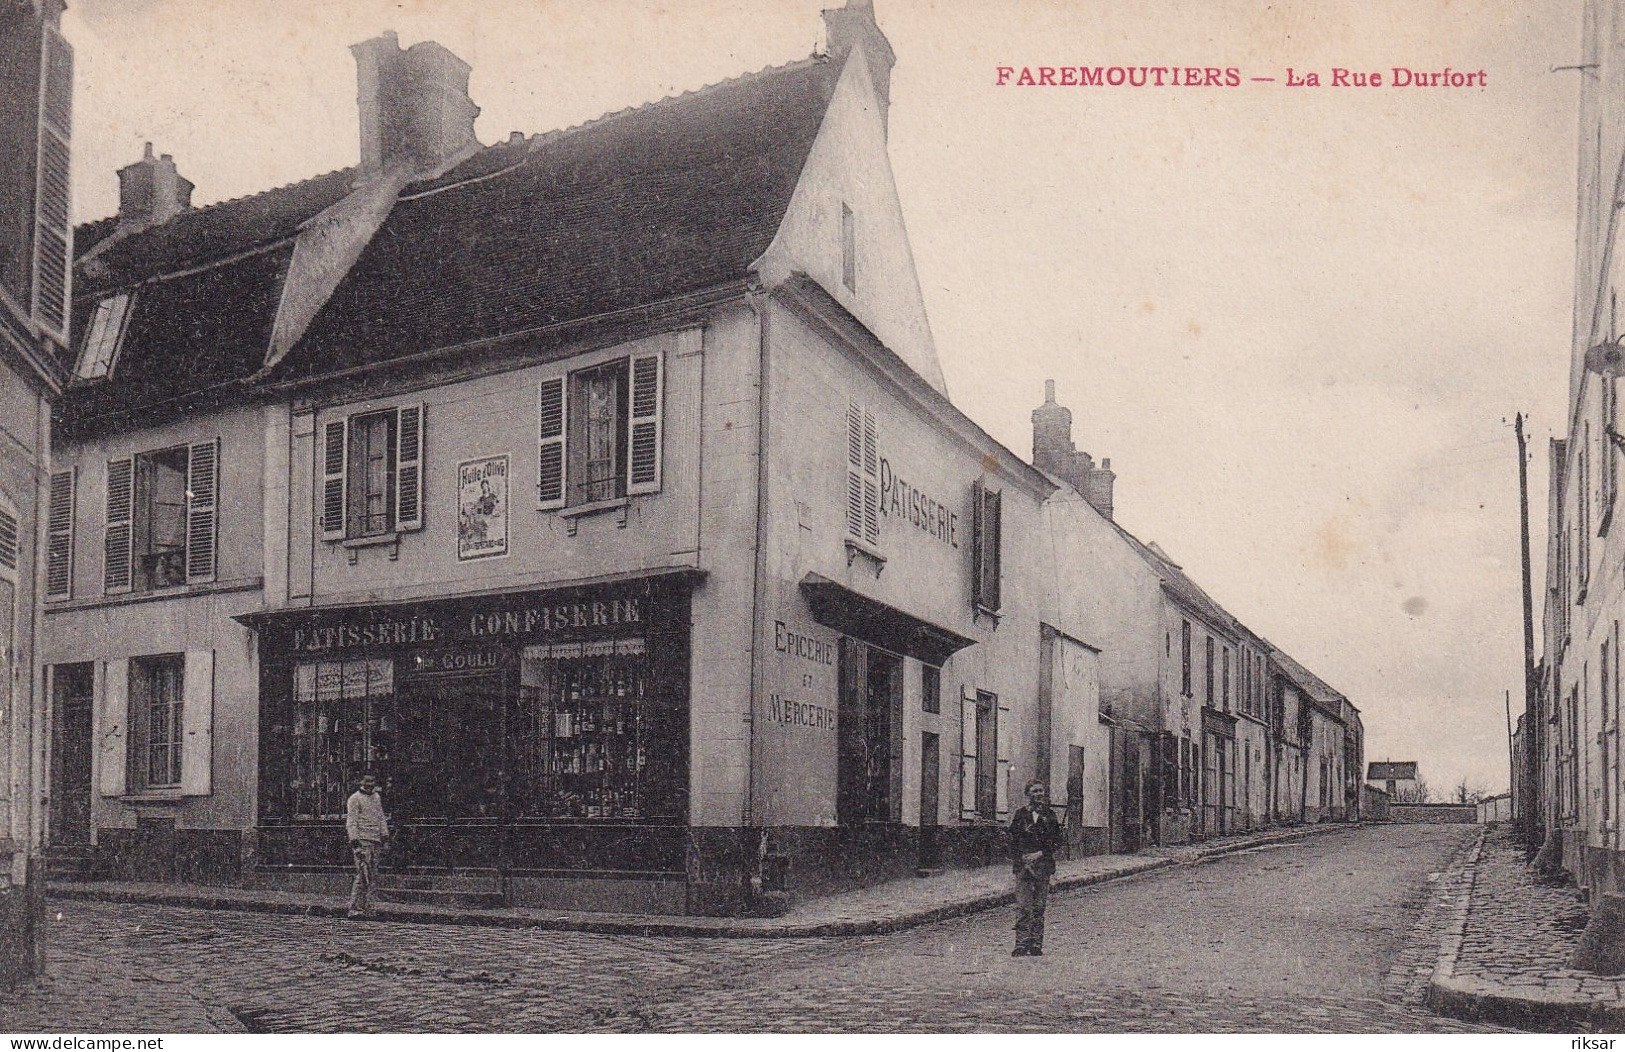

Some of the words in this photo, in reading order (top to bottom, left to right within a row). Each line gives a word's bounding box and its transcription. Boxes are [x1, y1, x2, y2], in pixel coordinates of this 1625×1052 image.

[879, 456, 958, 549] PATISSERIE
[469, 599, 643, 636] CONFISERIE
[774, 620, 832, 665] EPICERIE
[767, 694, 835, 731] MERCERIE
